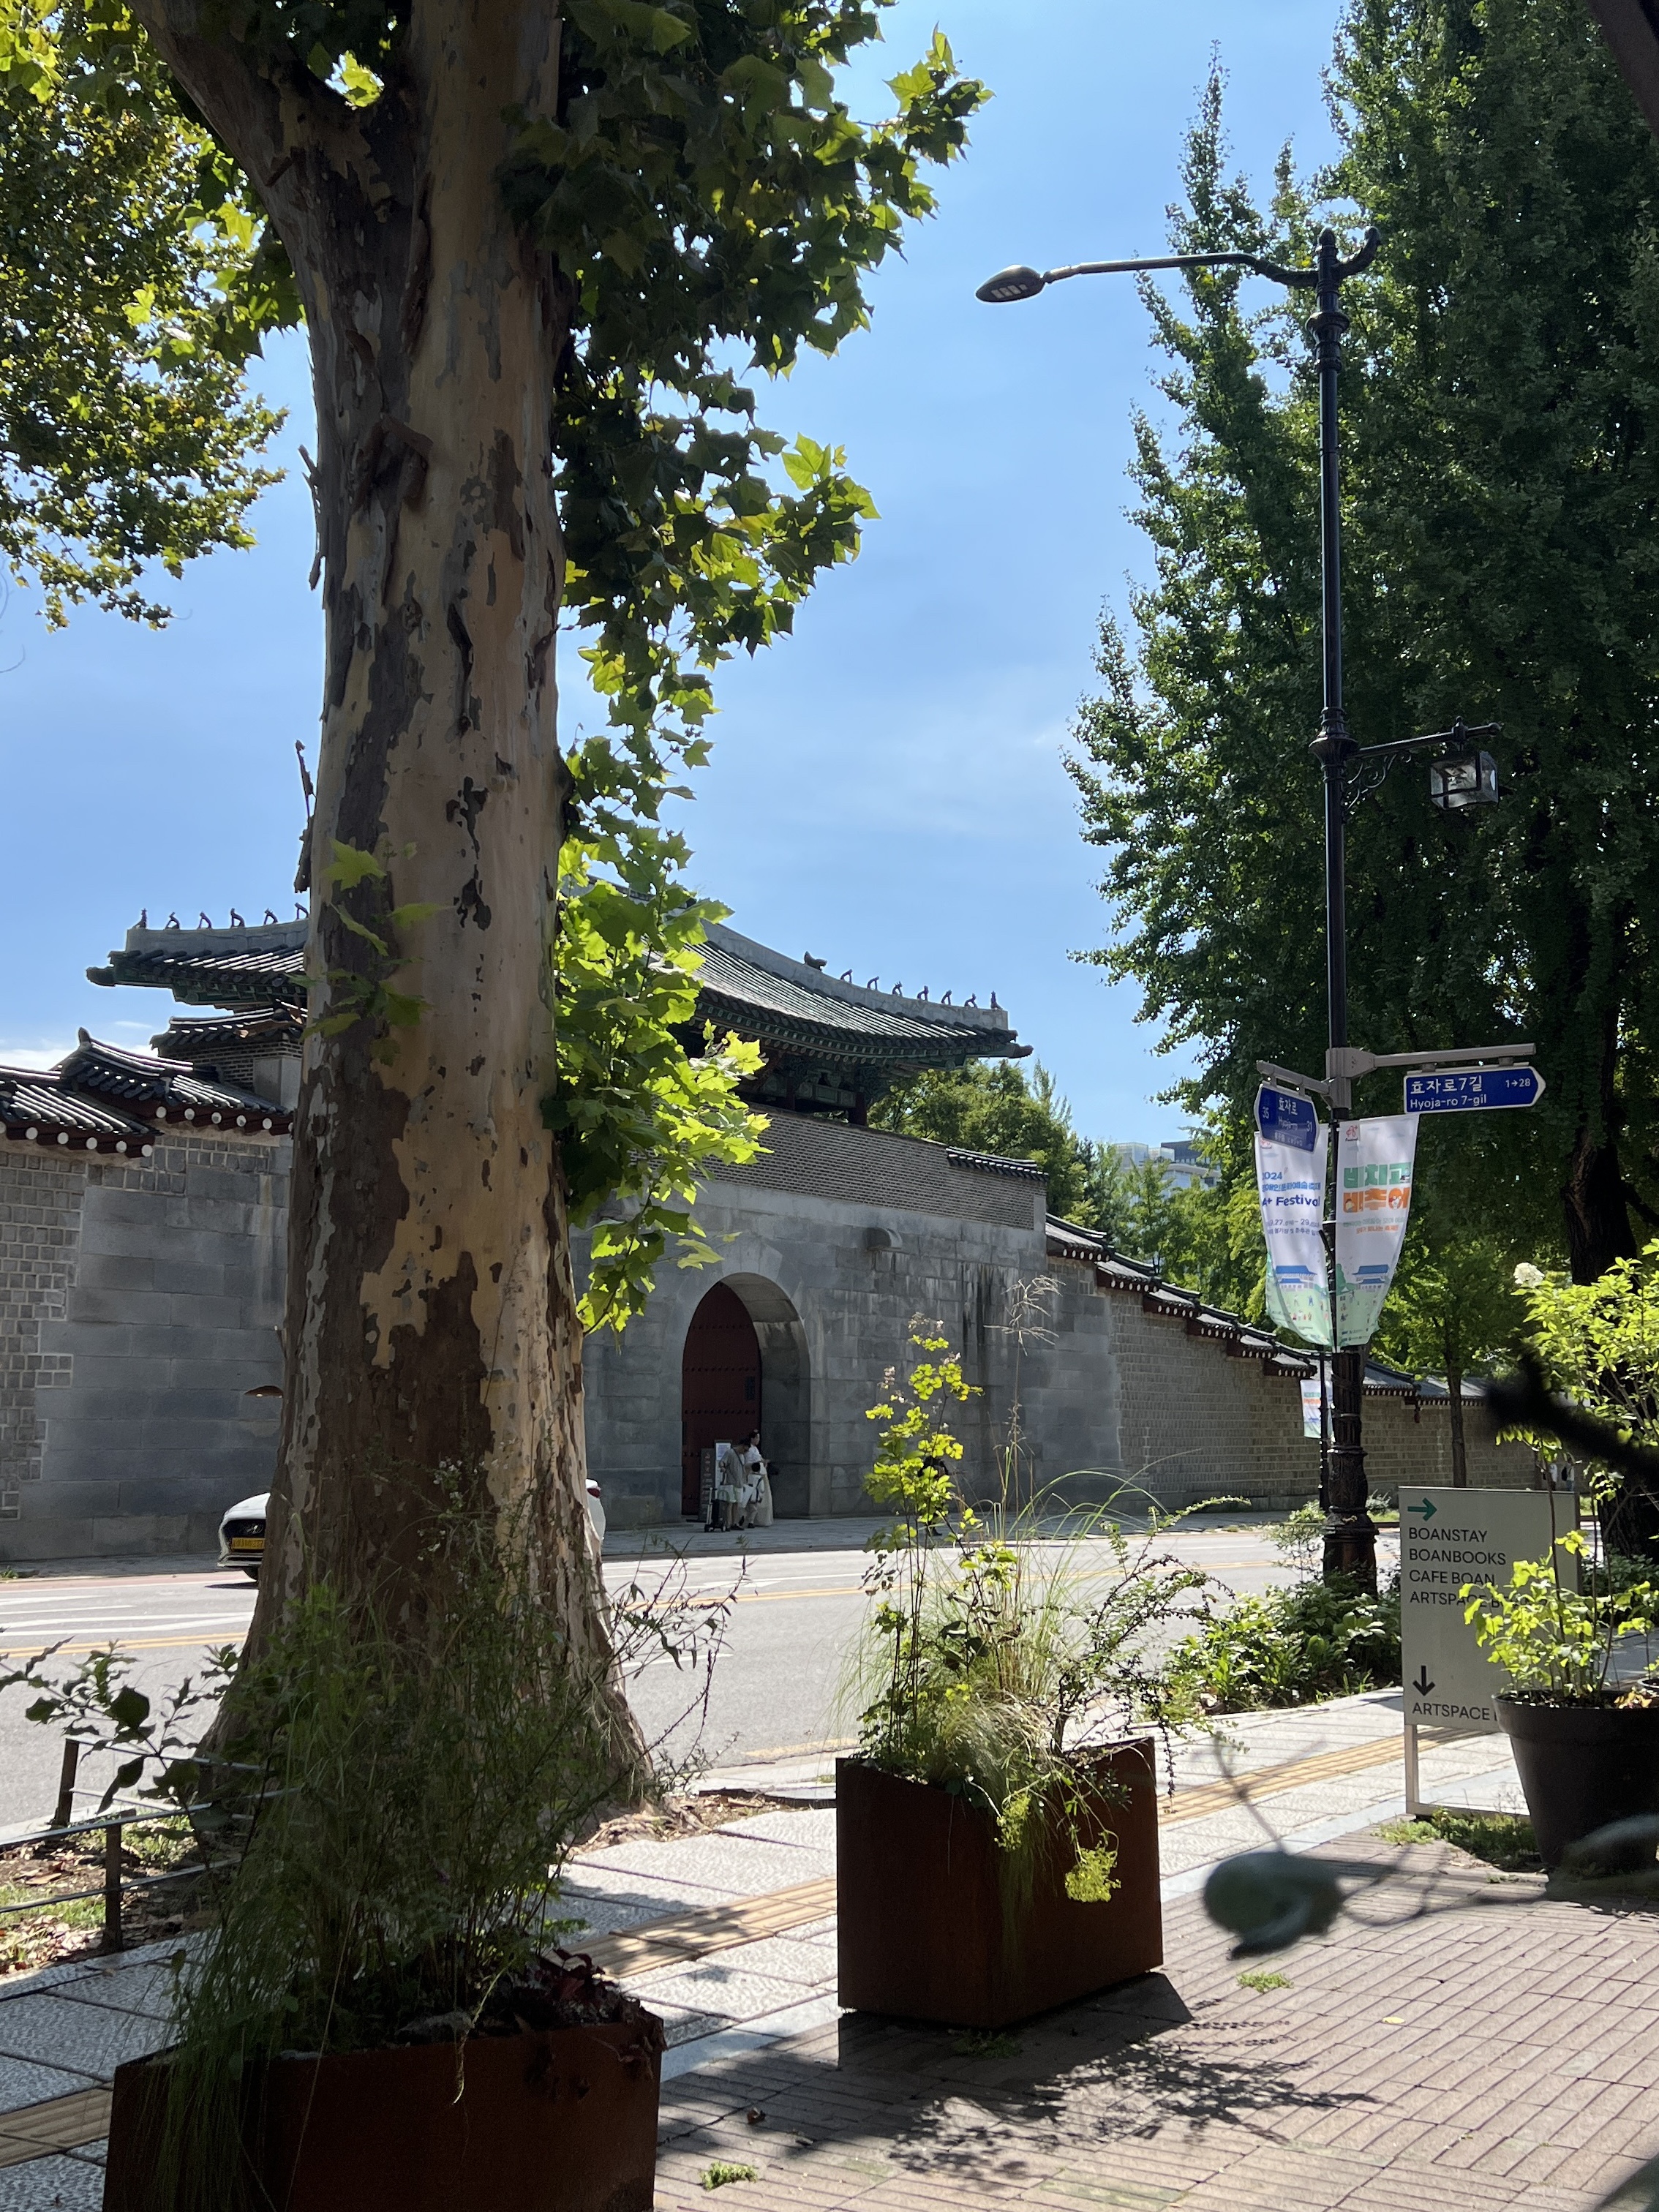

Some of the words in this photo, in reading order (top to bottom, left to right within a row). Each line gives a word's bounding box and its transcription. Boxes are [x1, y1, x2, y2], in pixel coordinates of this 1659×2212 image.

[1410, 1075, 1483, 1094] 효자로7길
[1278, 1097, 1298, 1116] 효자로
[1410, 1098, 1458, 1110] Hyoja-ro
[1462, 1094, 1487, 1106] 7-gil
[1306, 1120, 1313, 1133] 31
[1344, 1162, 1412, 1189] 비치고
[1276, 1194, 1321, 1207] Festival
[1343, 1187, 1412, 1214] 비추어
[1409, 1527, 1488, 1543] BOANSTAY
[1409, 1549, 1507, 1565] BOANBOOKS
[1409, 1569, 1448, 1584] CAFE
[1452, 1572, 1495, 1587] BOAN
[1412, 1702, 1491, 1721] ARTSPACE
